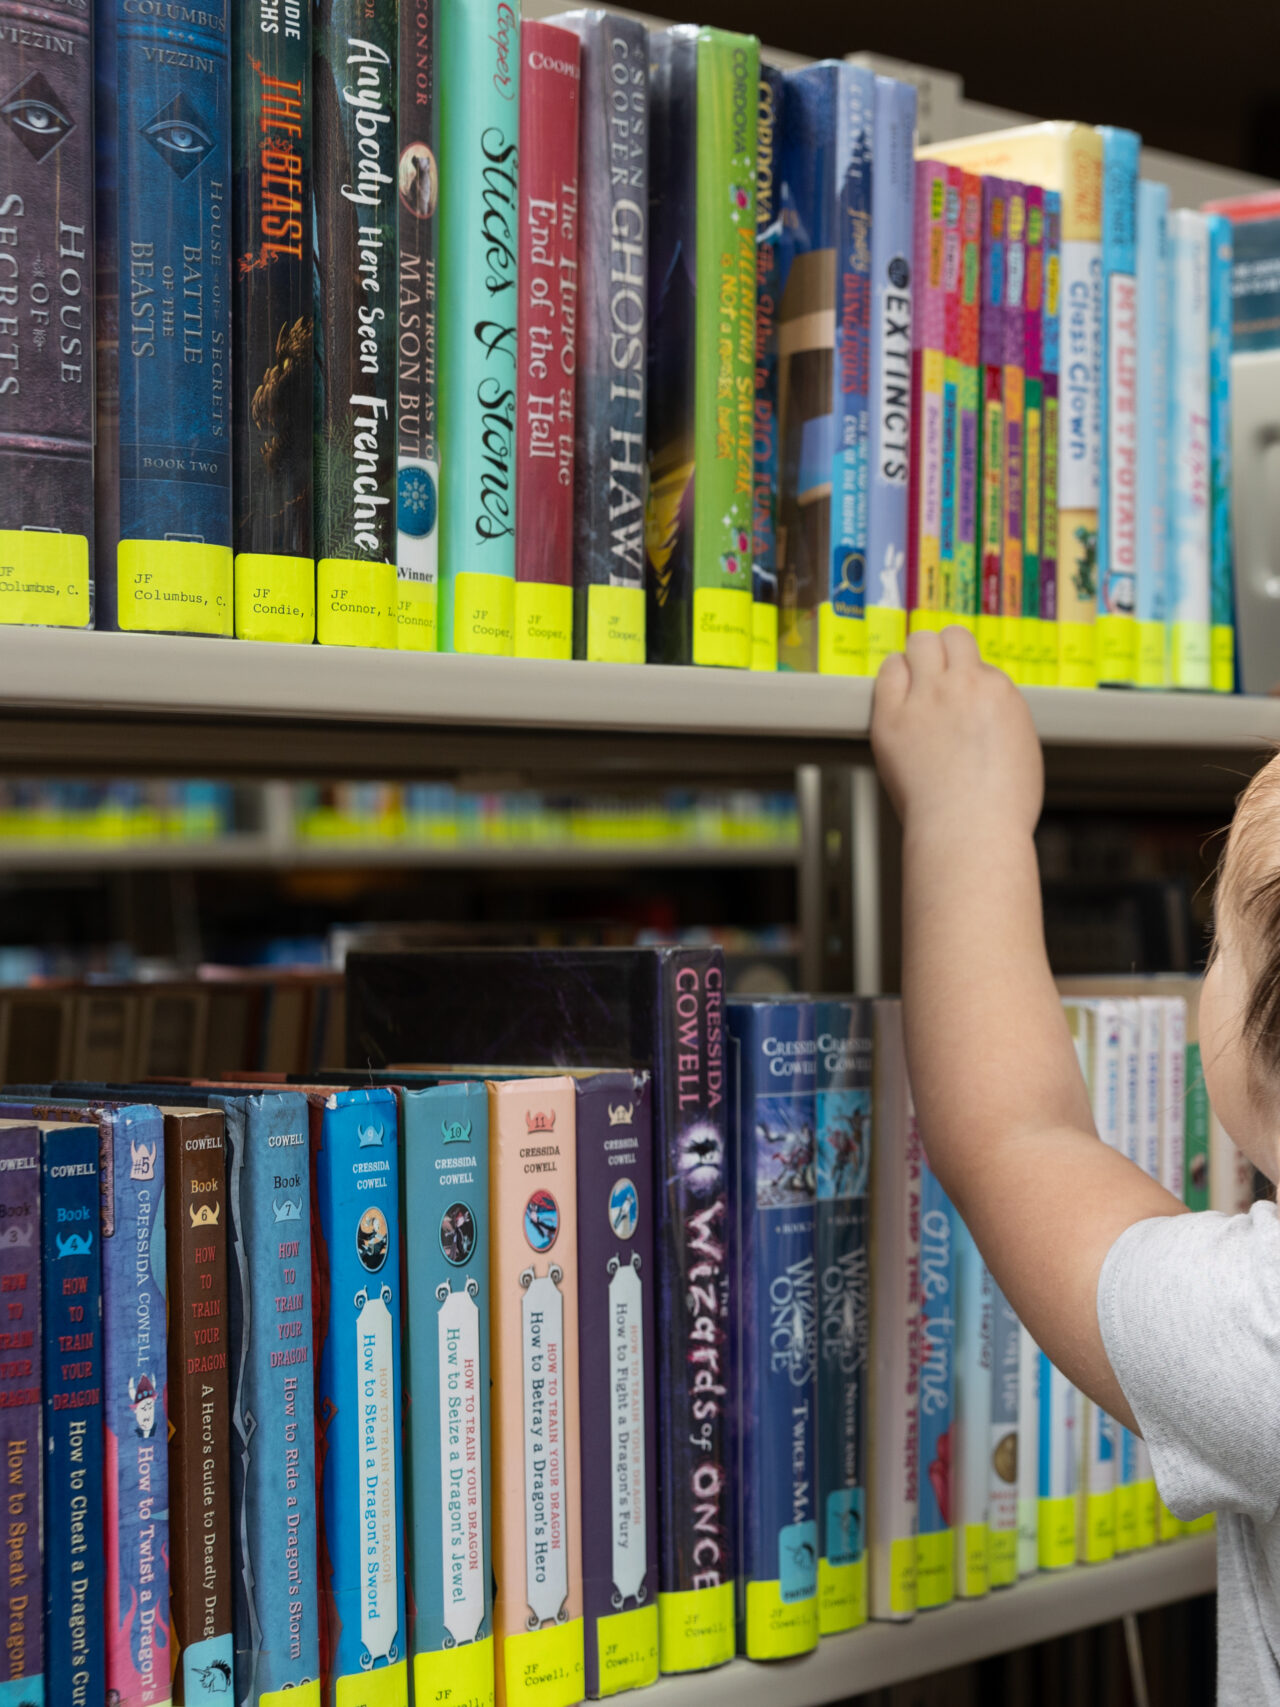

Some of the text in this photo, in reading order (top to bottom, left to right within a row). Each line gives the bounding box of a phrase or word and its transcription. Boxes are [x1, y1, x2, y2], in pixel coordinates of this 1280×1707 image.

[123, 0, 225, 32] COLUMBUS
[142, 46, 214, 75] VIZZINI
[416, 0, 428, 105] CONNOR
[488, 3, 514, 101] Cooper
[260, 79, 302, 138] THE
[611, 38, 629, 187] COOPER
[631, 68, 644, 188] SUSAN
[260, 150, 302, 260] BEAST
[561, 178, 578, 241] The
[209, 180, 224, 266] HOUSE
[29, 283, 50, 335] OF
[59, 221, 86, 384] HOUSE
[131, 240, 155, 358] BEASTS
[163, 265, 175, 337] OF THE
[182, 245, 203, 364] BATTLE
[341, 38, 392, 551] Anybody Here Seen Frenchie
[610, 198, 644, 418] GHOST
[399, 250, 421, 385] MASON
[528, 198, 557, 459] End of the Hall
[841, 273, 860, 395] DANGEROUS
[473, 127, 518, 546] Sticks & Stones
[737, 228, 754, 495] VALENTINA SALAZAR
[211, 330, 224, 438] SECRETS
[882, 295, 909, 483] EXTINCTS
[559, 388, 573, 422] at
[1068, 363, 1090, 461] Clown
[143, 457, 218, 474] BOOK TWO
[557, 435, 572, 487] the
[134, 573, 153, 585] JF
[398, 567, 434, 583] Winner
[134, 589, 226, 607] Columbus, C.
[253, 589, 271, 599] JF
[253, 603, 303, 618] Condie,
[331, 589, 348, 600] JF
[473, 610, 488, 621] JF
[528, 614, 541, 625] JF
[473, 625, 514, 641] Cooper,
[527, 627, 567, 642] Cooper,
[676, 967, 699, 1111] COWELL
[705, 967, 722, 1108] CRESSIDA
[185, 1136, 223, 1151] COWELL
[268, 1132, 305, 1148] COWELL
[519, 1145, 561, 1158] CRESSIDA
[603, 1137, 639, 1152] CRESSIDA
[51, 1162, 96, 1178] COWELL
[352, 1160, 390, 1174] CRESSIDA
[435, 1156, 477, 1169] CRESSIDA
[523, 1161, 557, 1174] COWELL
[608, 1153, 637, 1168] COWELL
[190, 1177, 218, 1194] Book
[273, 1174, 301, 1189] Book
[356, 1177, 388, 1190] COWELL
[439, 1172, 474, 1185] COWELL
[56, 1206, 91, 1223] Book
[195, 1246, 216, 1265] HOW
[278, 1241, 300, 1259] HOW
[62, 1276, 88, 1296] HOW
[136, 1189, 151, 1368] CRESSIDA COWELL
[191, 1299, 220, 1319] TRAIN
[274, 1294, 304, 1313] TRAIN
[821, 1266, 843, 1361] ONCE
[921, 1210, 955, 1416] one time
[193, 1327, 220, 1345] YOUR
[276, 1320, 302, 1340] YOUR
[770, 1275, 793, 1373] ONCE
[58, 1332, 94, 1352] TRAIN
[270, 1347, 308, 1369] DRAGON
[61, 1361, 93, 1381] YOUR
[187, 1353, 227, 1376] DRAGON
[53, 1388, 100, 1412] DRAGON
[69, 1420, 86, 1463] How
[530, 1311, 548, 1584] How to Betray a Dragon's Hero
[547, 1343, 561, 1550] HOW TO TRAIN YOUR DRAGON
[689, 1423, 713, 1452] of
[792, 1398, 810, 1474] TWICE
[70, 1468, 86, 1490] to
[363, 1334, 380, 1620] How to Steal a Dragon's Sword
[447, 1328, 466, 1604] How to Seize a Dragon's Jewel
[464, 1359, 479, 1571] HOW TO TRAIN YOUR DRAGON
[70, 1495, 88, 1555] Cheat
[284, 1377, 302, 1661] How to Ride a Dragon's Storm
[692, 1462, 725, 1591] ONCE
[71, 1560, 85, 1573] a
[137, 1445, 156, 1703] How to Twist a Dragon's
[68, 1577, 89, 1667] Dragon's
